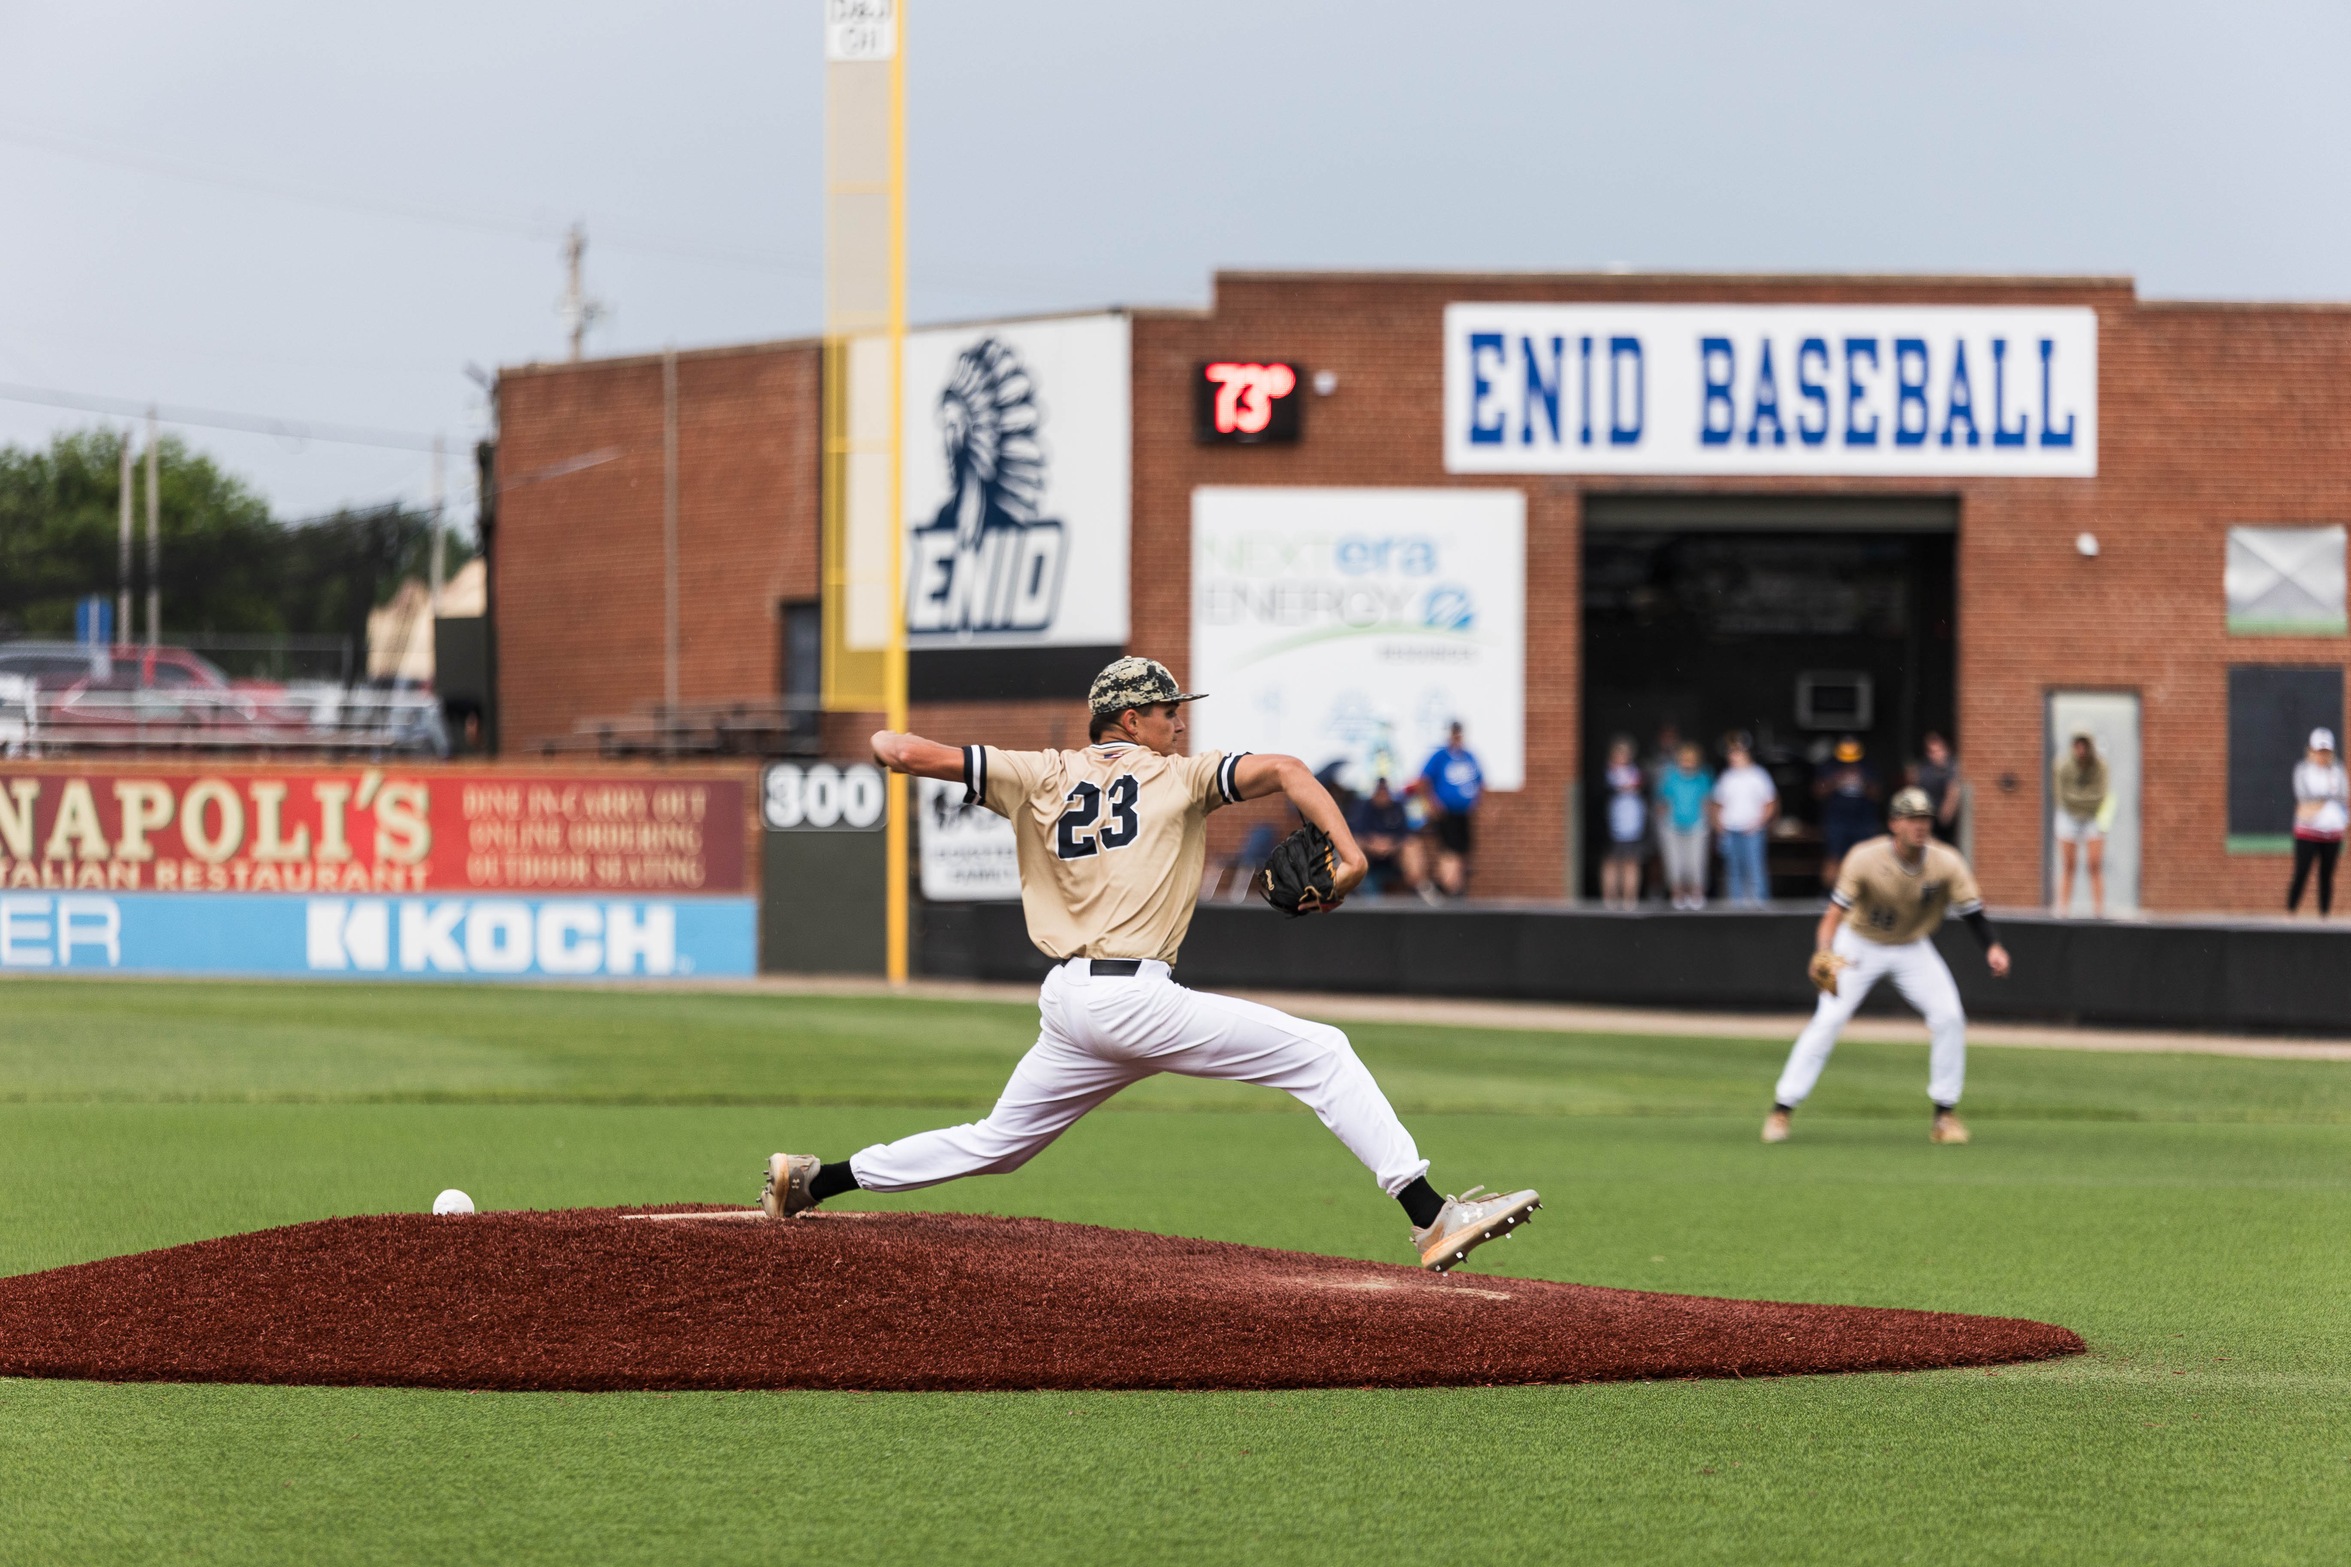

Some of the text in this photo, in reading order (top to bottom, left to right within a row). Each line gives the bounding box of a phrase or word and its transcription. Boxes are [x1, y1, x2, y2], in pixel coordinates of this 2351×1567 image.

[1468, 332, 2076, 448] ENID BASEBALL
[907, 525, 1068, 632] ENID
[462, 785, 524, 819] DINE
[764, 763, 885, 828] 300
[1057, 773, 1141, 860] 23
[466, 853, 591, 885] OUTDOOR
[468, 820, 565, 853] ONLINE
[154, 858, 429, 893] RESTAURANT
[0, 895, 121, 967] ER
[399, 902, 677, 974] KOCH
